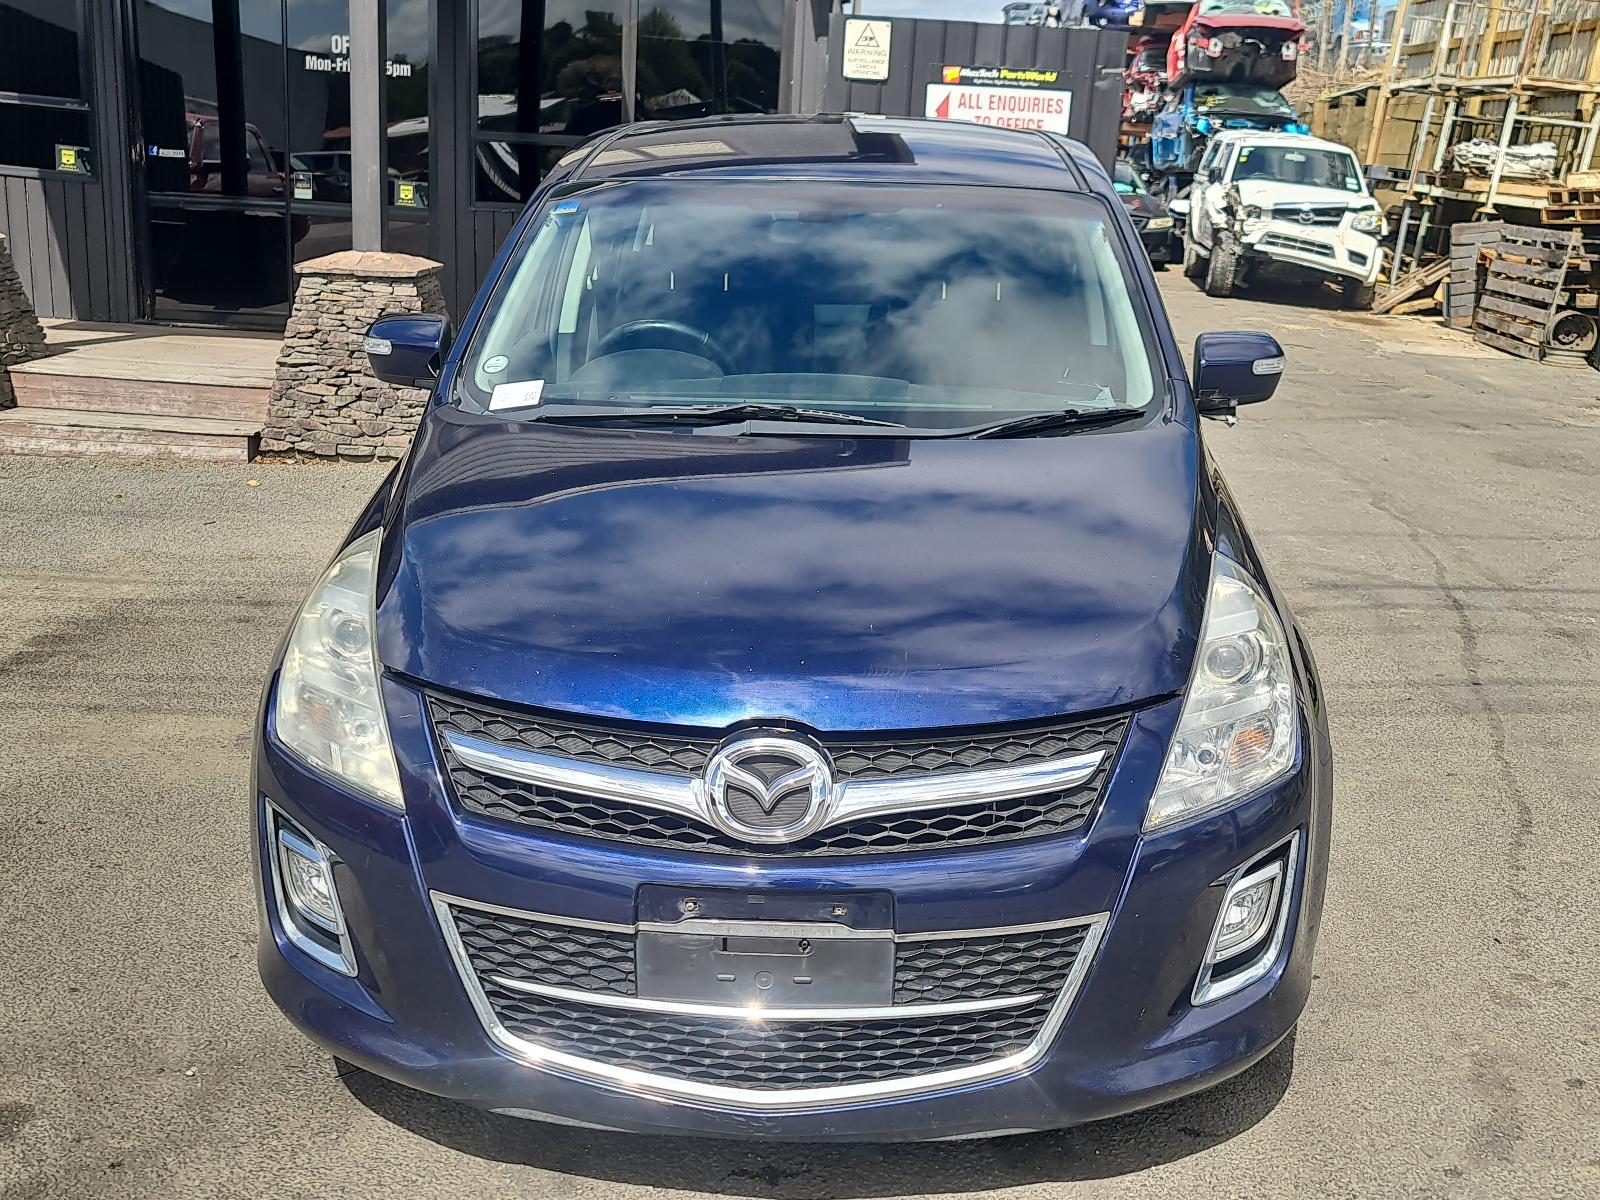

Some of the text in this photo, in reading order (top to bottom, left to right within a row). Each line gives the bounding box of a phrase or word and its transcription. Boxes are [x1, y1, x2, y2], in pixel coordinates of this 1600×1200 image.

[847, 48, 887, 57] WARNING
[957, 93, 1065, 115] ALL ENQUIRIES
